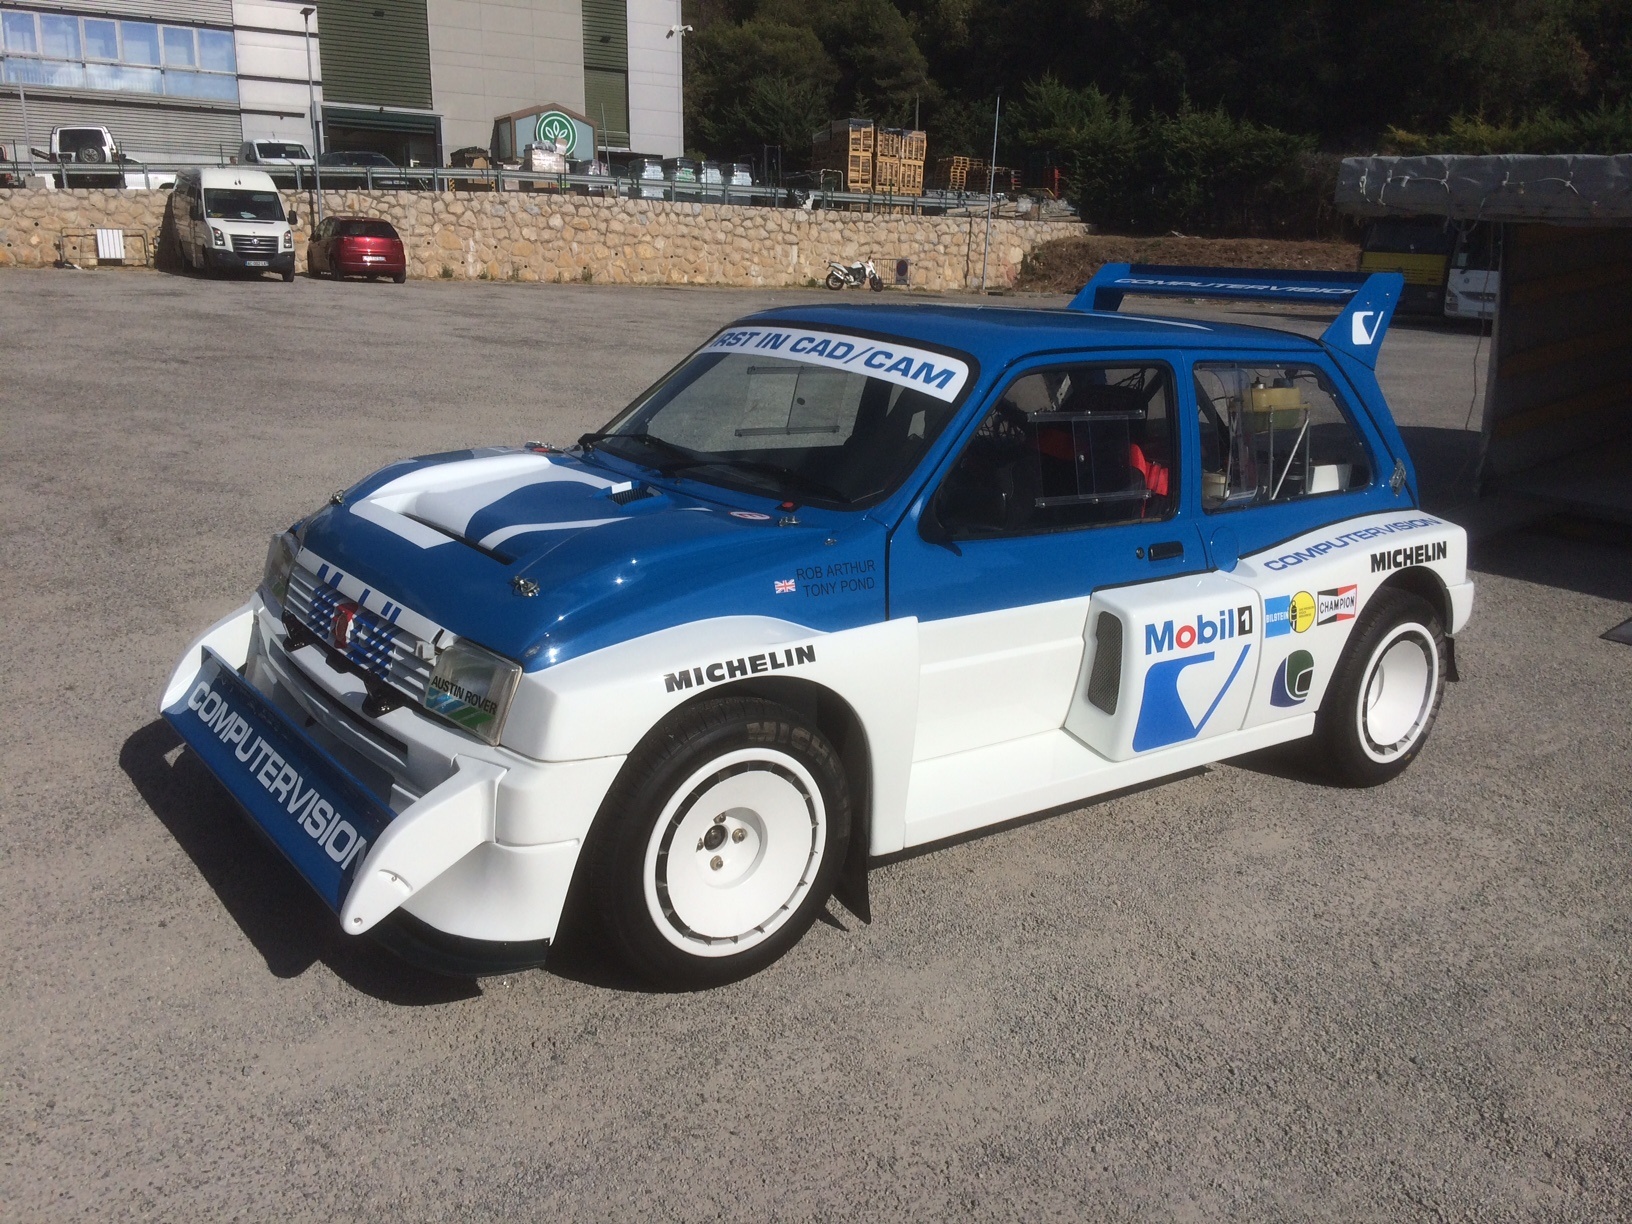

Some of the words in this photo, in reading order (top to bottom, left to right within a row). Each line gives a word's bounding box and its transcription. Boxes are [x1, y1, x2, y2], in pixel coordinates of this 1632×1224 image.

[709, 331, 760, 348] IRST
[756, 332, 791, 350] IN
[788, 336, 957, 390] CAD/CAM
[1263, 517, 1442, 571] COMPUTERVISION
[1370, 541, 1448, 573] MICHELIN
[796, 566, 823, 581] ROB
[826, 559, 876, 577] ARTHUR
[803, 582, 837, 598] TONY
[840, 577, 875, 593] POND
[1266, 610, 1289, 624] BILSTEIN
[1319, 595, 1355, 614] CHAMPION
[664, 644, 816, 694] MICHELIN
[431, 675, 465, 700] AUSTIN
[465, 690, 498, 716] ROVER
